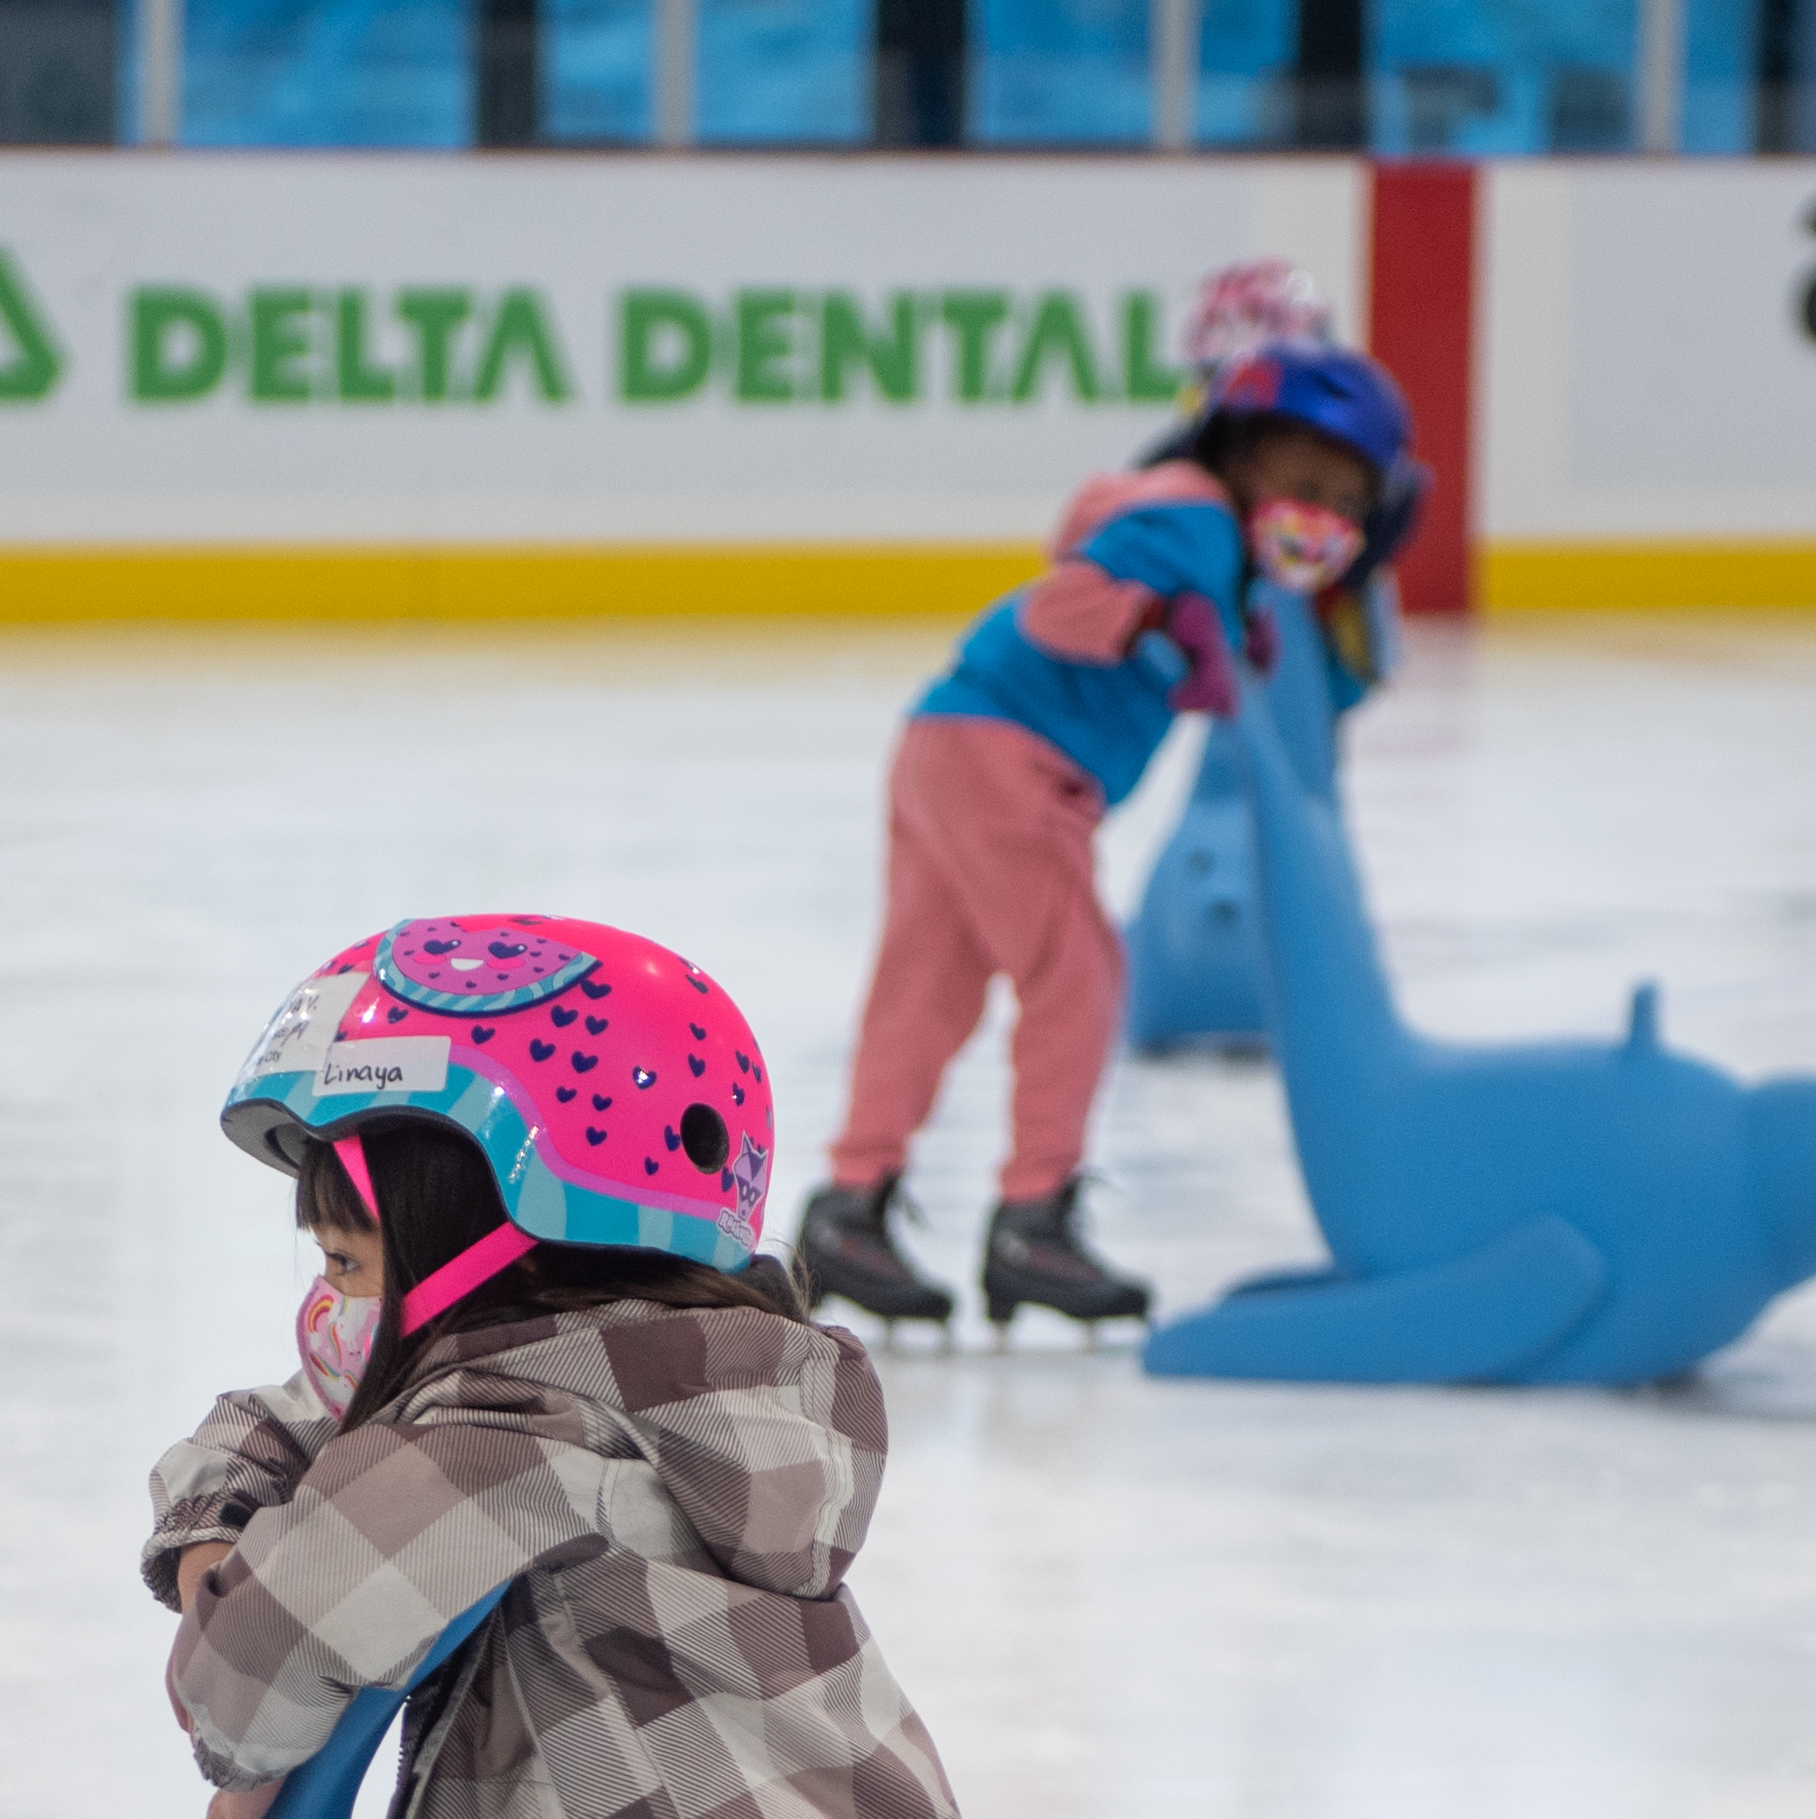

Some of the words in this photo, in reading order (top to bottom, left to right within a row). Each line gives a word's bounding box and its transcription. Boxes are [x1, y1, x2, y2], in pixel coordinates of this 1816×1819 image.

[125, 281, 570, 407] DELTA
[615, 282, 1185, 406] DENTAL
[323, 1062, 403, 1090] Linaya
